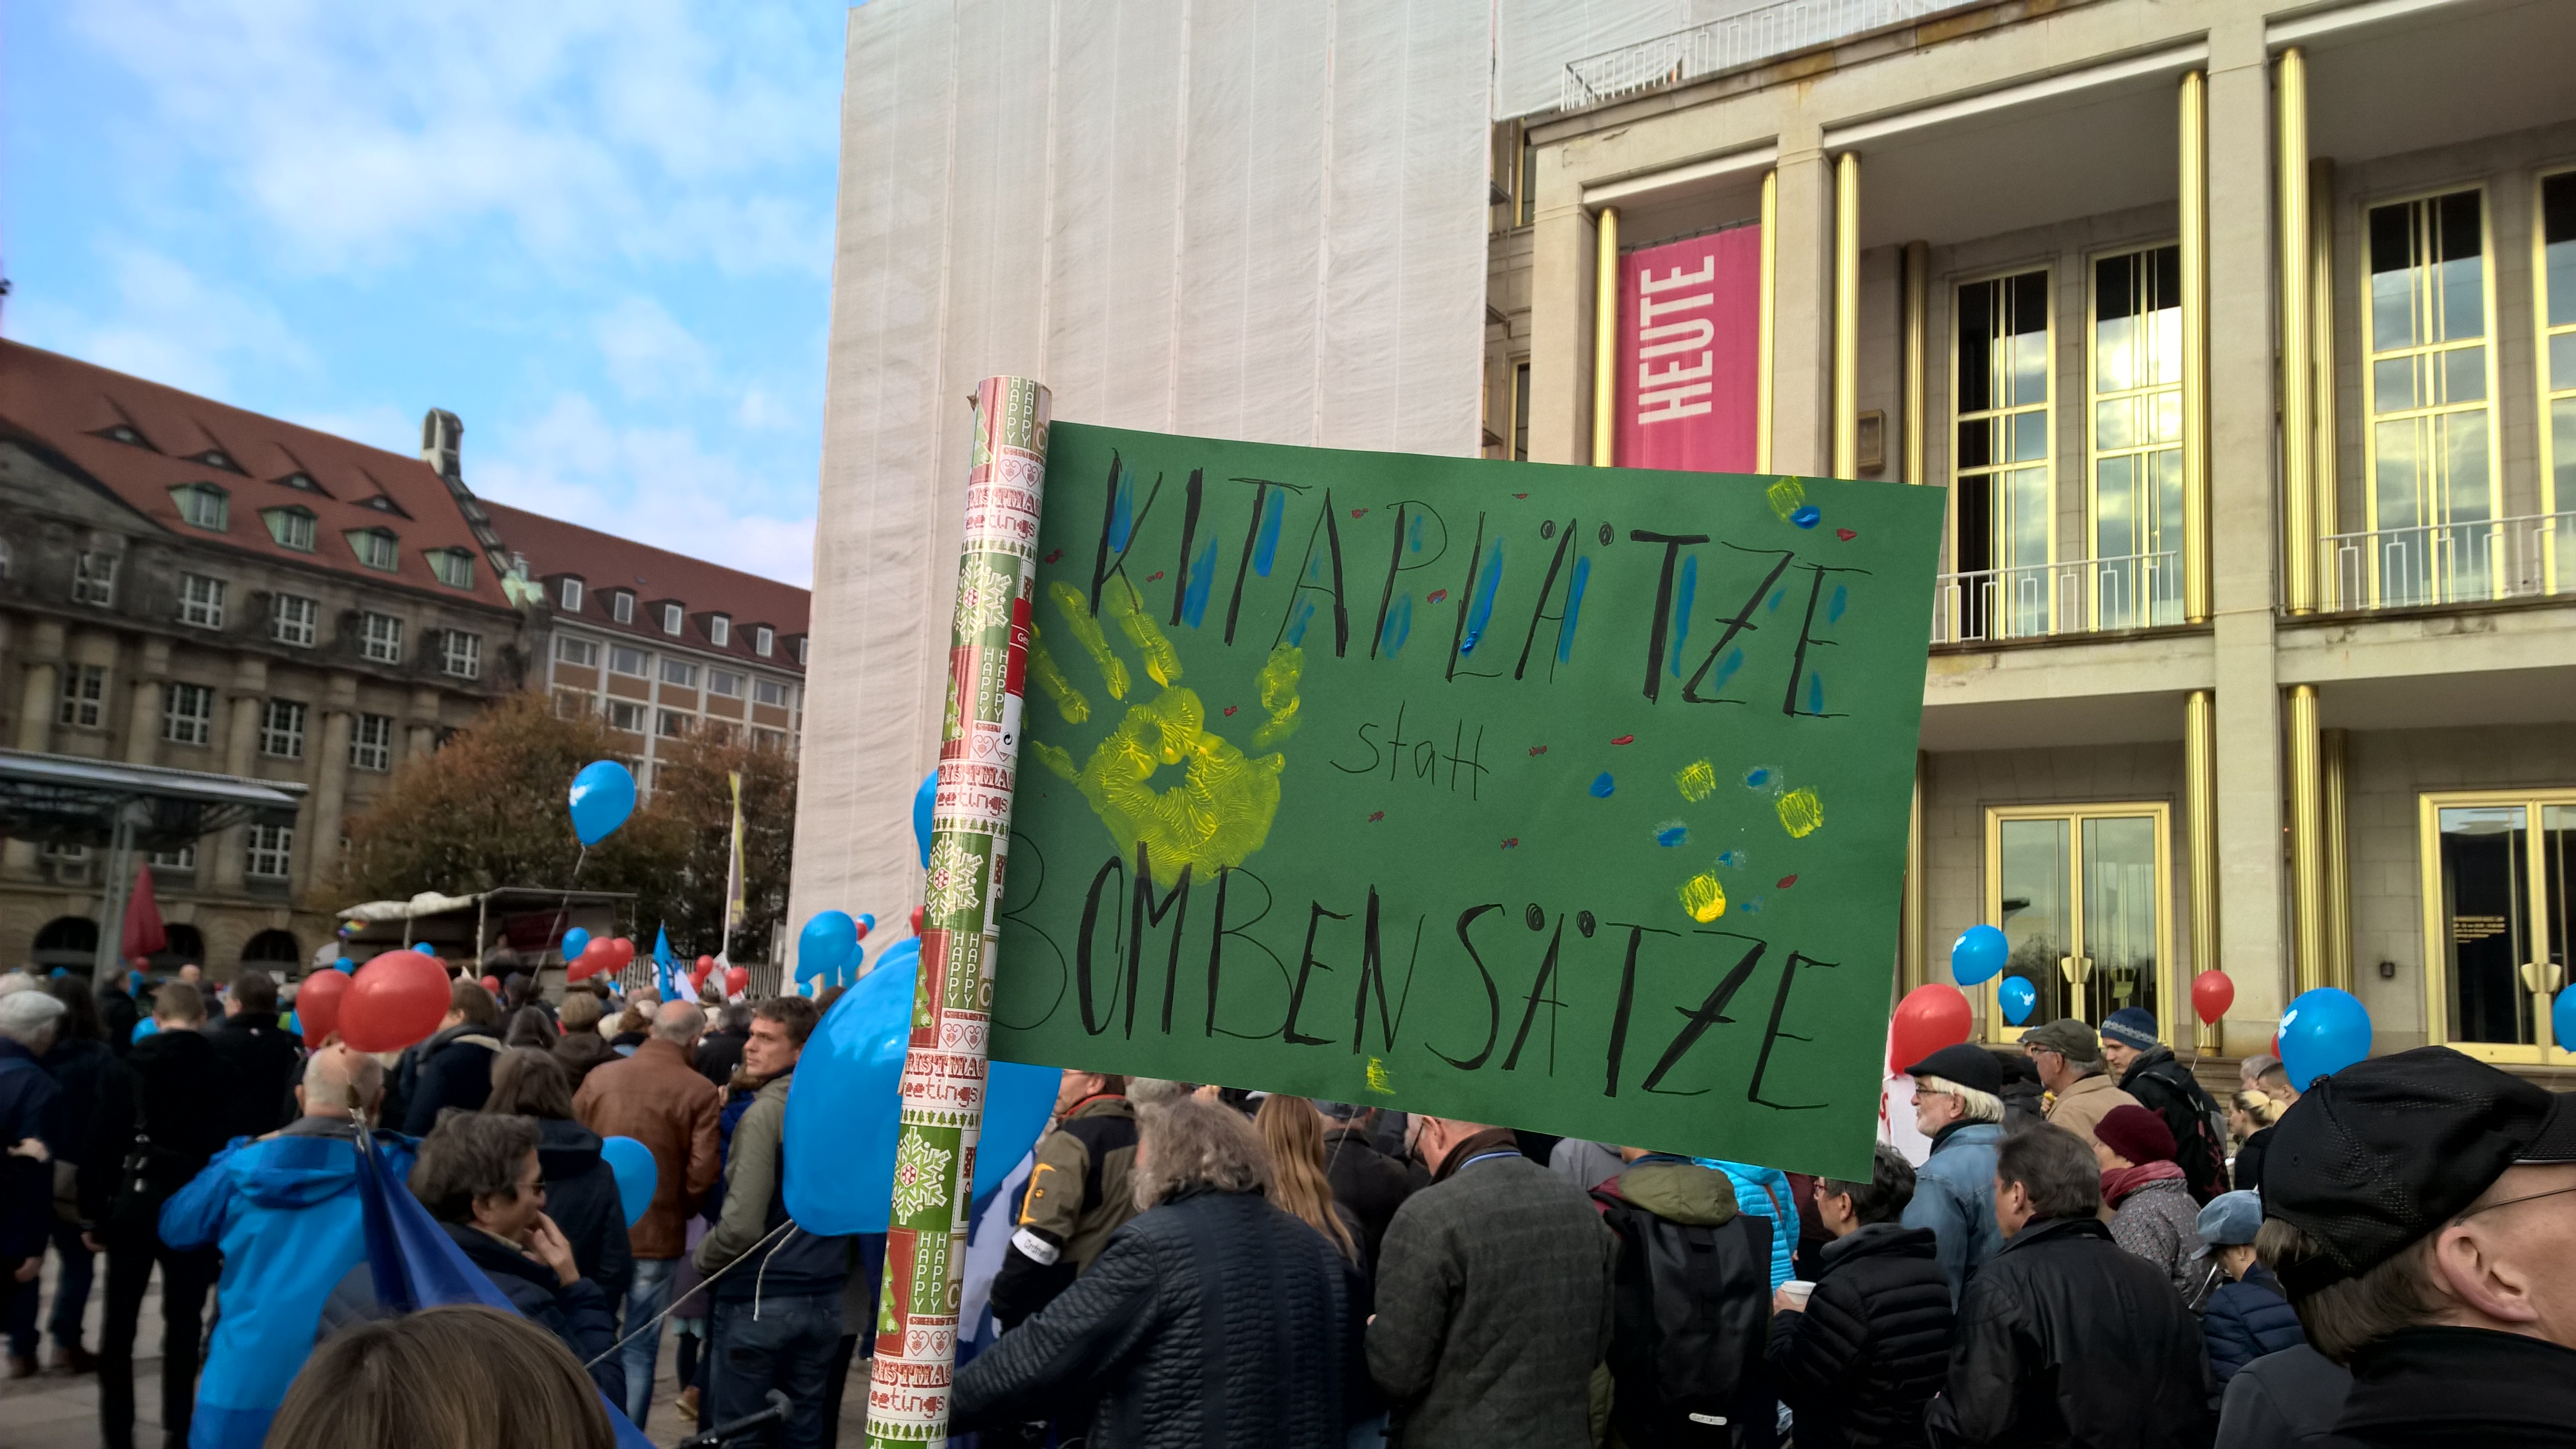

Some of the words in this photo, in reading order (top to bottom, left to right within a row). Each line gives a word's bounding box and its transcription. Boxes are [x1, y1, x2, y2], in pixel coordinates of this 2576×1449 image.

[1638, 254, 1714, 425] HEUTE
[1007, 377, 1021, 444] HAPPY
[1022, 380, 1035, 448] HAPPY
[1089, 447, 1873, 717] KITAPLÄTZE
[979, 648, 995, 720] HAPPY
[948, 931, 965, 1007] HAPPY
[963, 933, 980, 1009] HAPPY
[991, 830, 1841, 1110] BOMBENSÄTZE
[914, 1232, 932, 1313] HAPPY
[930, 1233, 947, 1314] HAPPY
[869, 1387, 945, 1419] eetings
